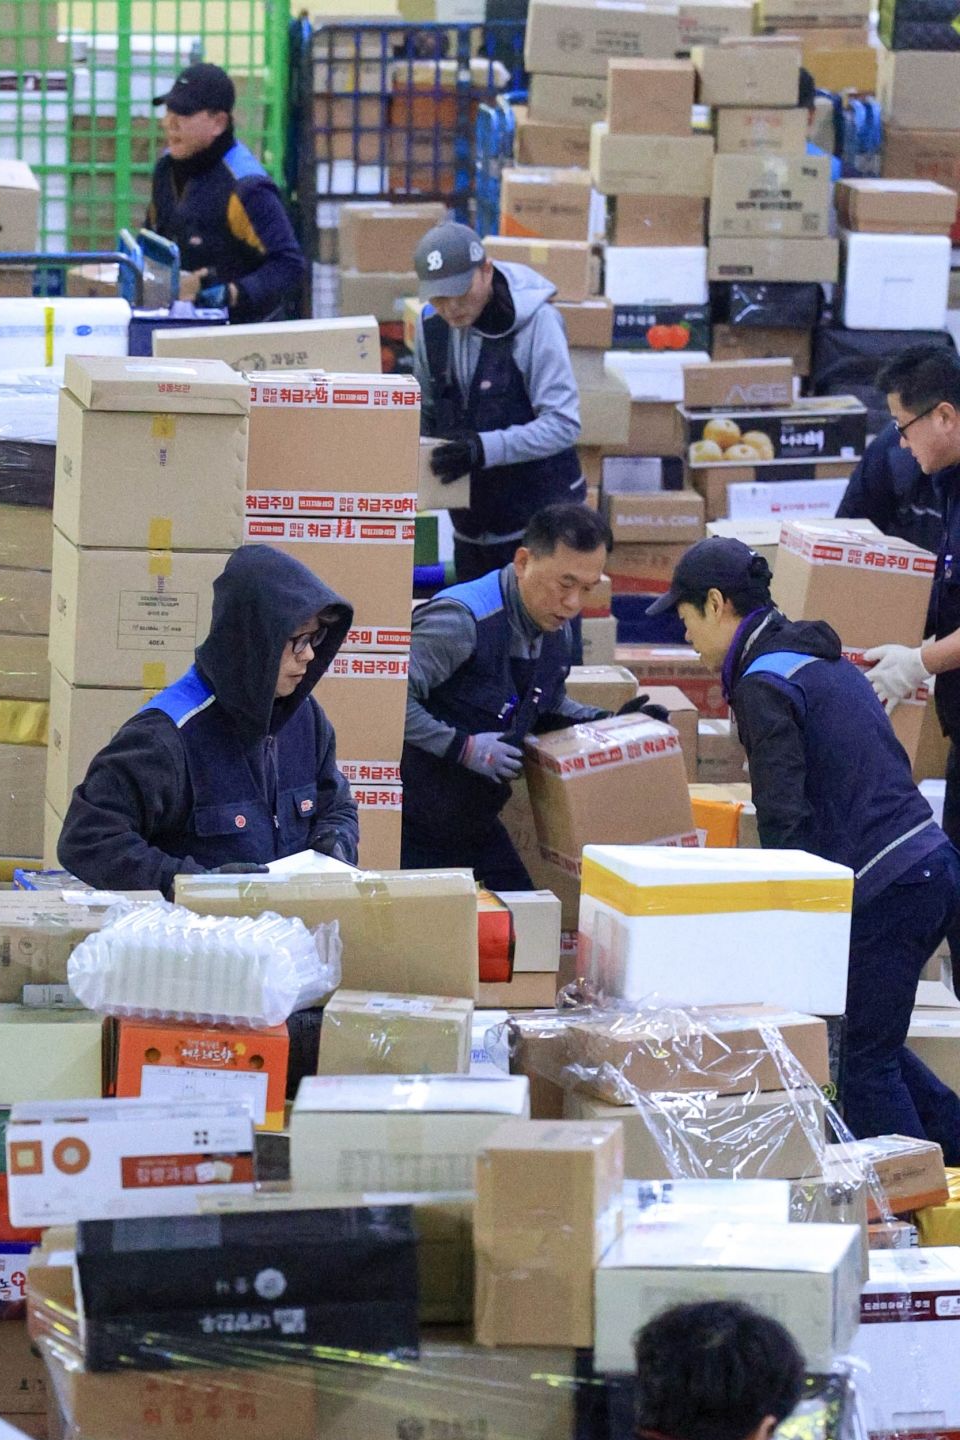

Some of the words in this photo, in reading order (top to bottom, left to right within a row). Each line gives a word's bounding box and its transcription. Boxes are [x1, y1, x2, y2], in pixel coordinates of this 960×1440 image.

[246, 495, 293, 510] 취급주의
[863, 552, 909, 570] 취급주의
[342, 631, 372, 644] 주의
[352, 659, 399, 675] 취급주의
